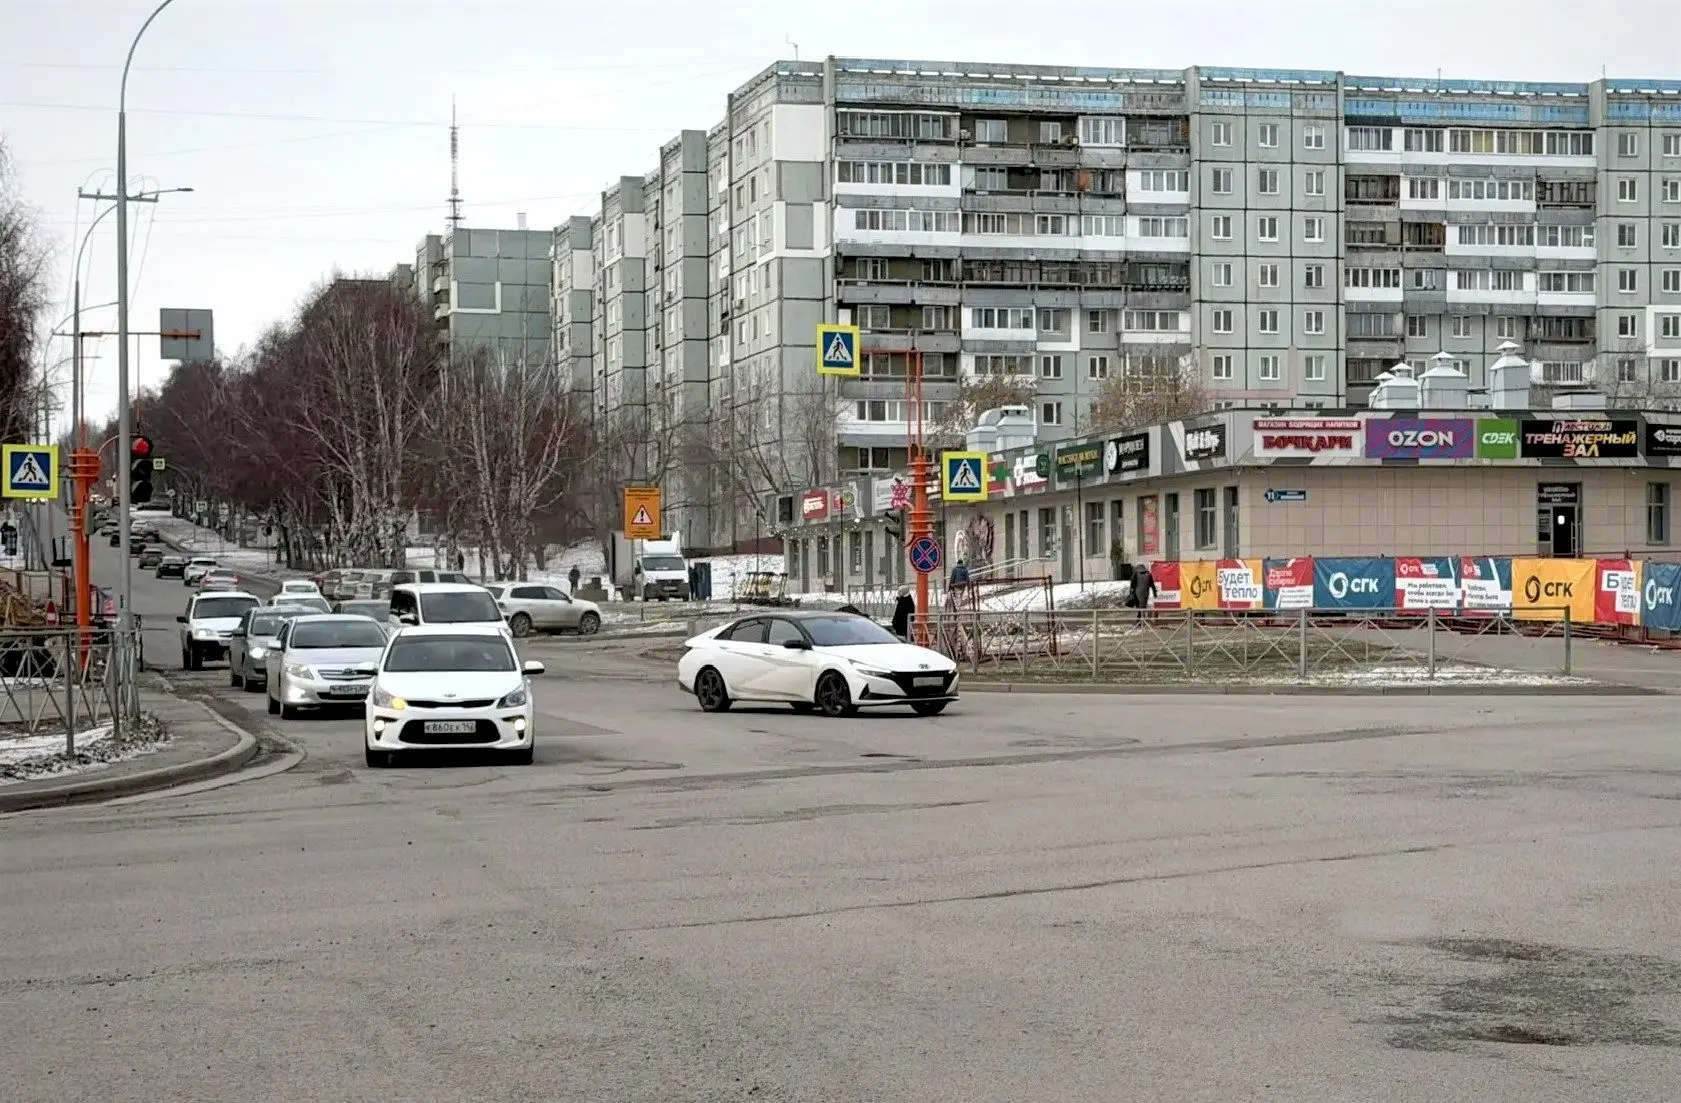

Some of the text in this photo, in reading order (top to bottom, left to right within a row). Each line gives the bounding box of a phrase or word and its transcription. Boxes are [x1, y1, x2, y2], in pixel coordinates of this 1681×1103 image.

[1262, 435, 1353, 452] БОЧКАРИ
[1388, 430, 1454, 447] OZON
[1525, 430, 1637, 445] ТРЕНАЖЕРНЫЙ
[1562, 444, 1600, 458] ЗАЛ
[1219, 570, 1250, 585] Будет
[1226, 585, 1258, 599] тепло
[1350, 578, 1379, 593] СГК
[1544, 582, 1573, 597] СГК
